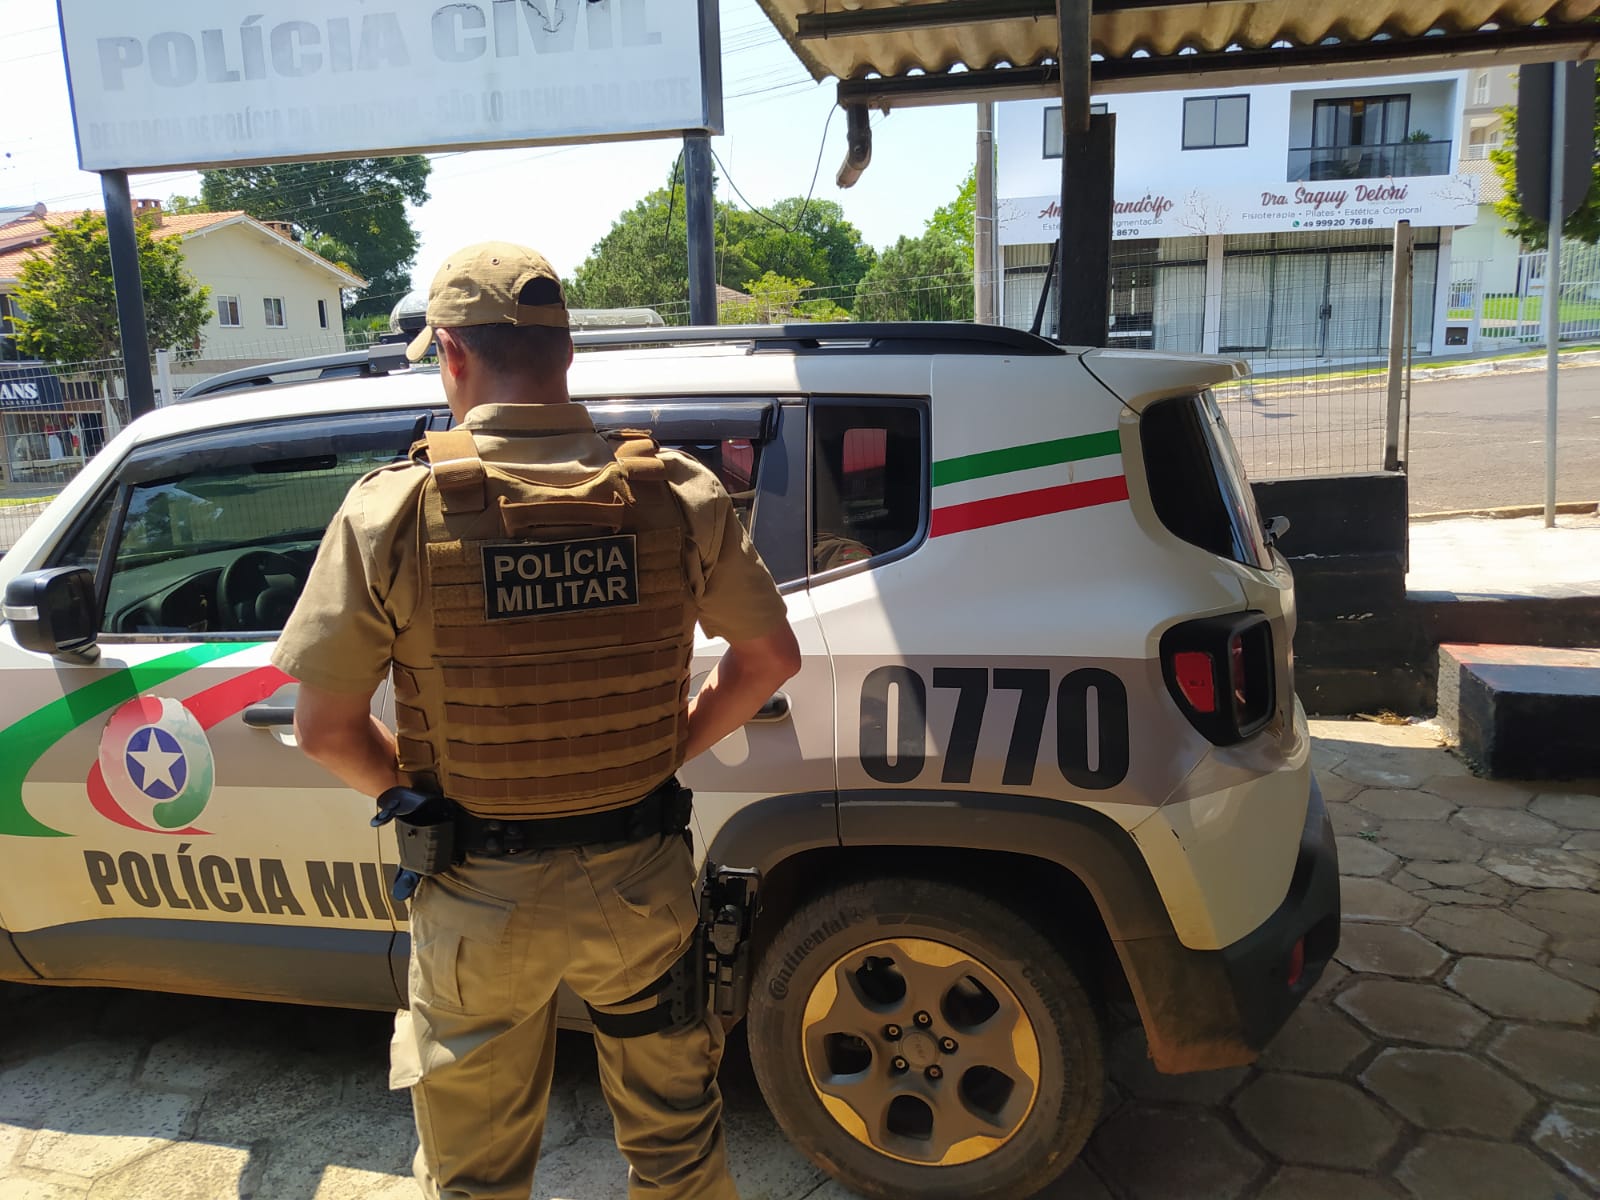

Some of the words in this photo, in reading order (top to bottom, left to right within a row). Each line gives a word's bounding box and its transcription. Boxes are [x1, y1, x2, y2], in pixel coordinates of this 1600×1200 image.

[97, 12, 412, 91] POLÍCIA
[431, 0, 662, 63] CIVIL
[1112, 195, 1174, 218] andolfo
[1241, 211, 1296, 221] Fisioterapia
[1305, 208, 1335, 217] Pilates
[1344, 207, 1380, 217] Estética
[1382, 206, 1423, 215] Corporal
[1261, 192, 1288, 206] Dra.
[1355, 184, 1408, 202] Detoni
[1316, 218, 1346, 228] 99920
[1349, 217, 1374, 226] 7686
[494, 545, 628, 582] POLÍCIA
[497, 576, 629, 613] MILITAR
[859, 664, 1131, 791] 0770
[83, 842, 306, 916] POLÍCIA
[768, 911, 851, 1001] Continental
